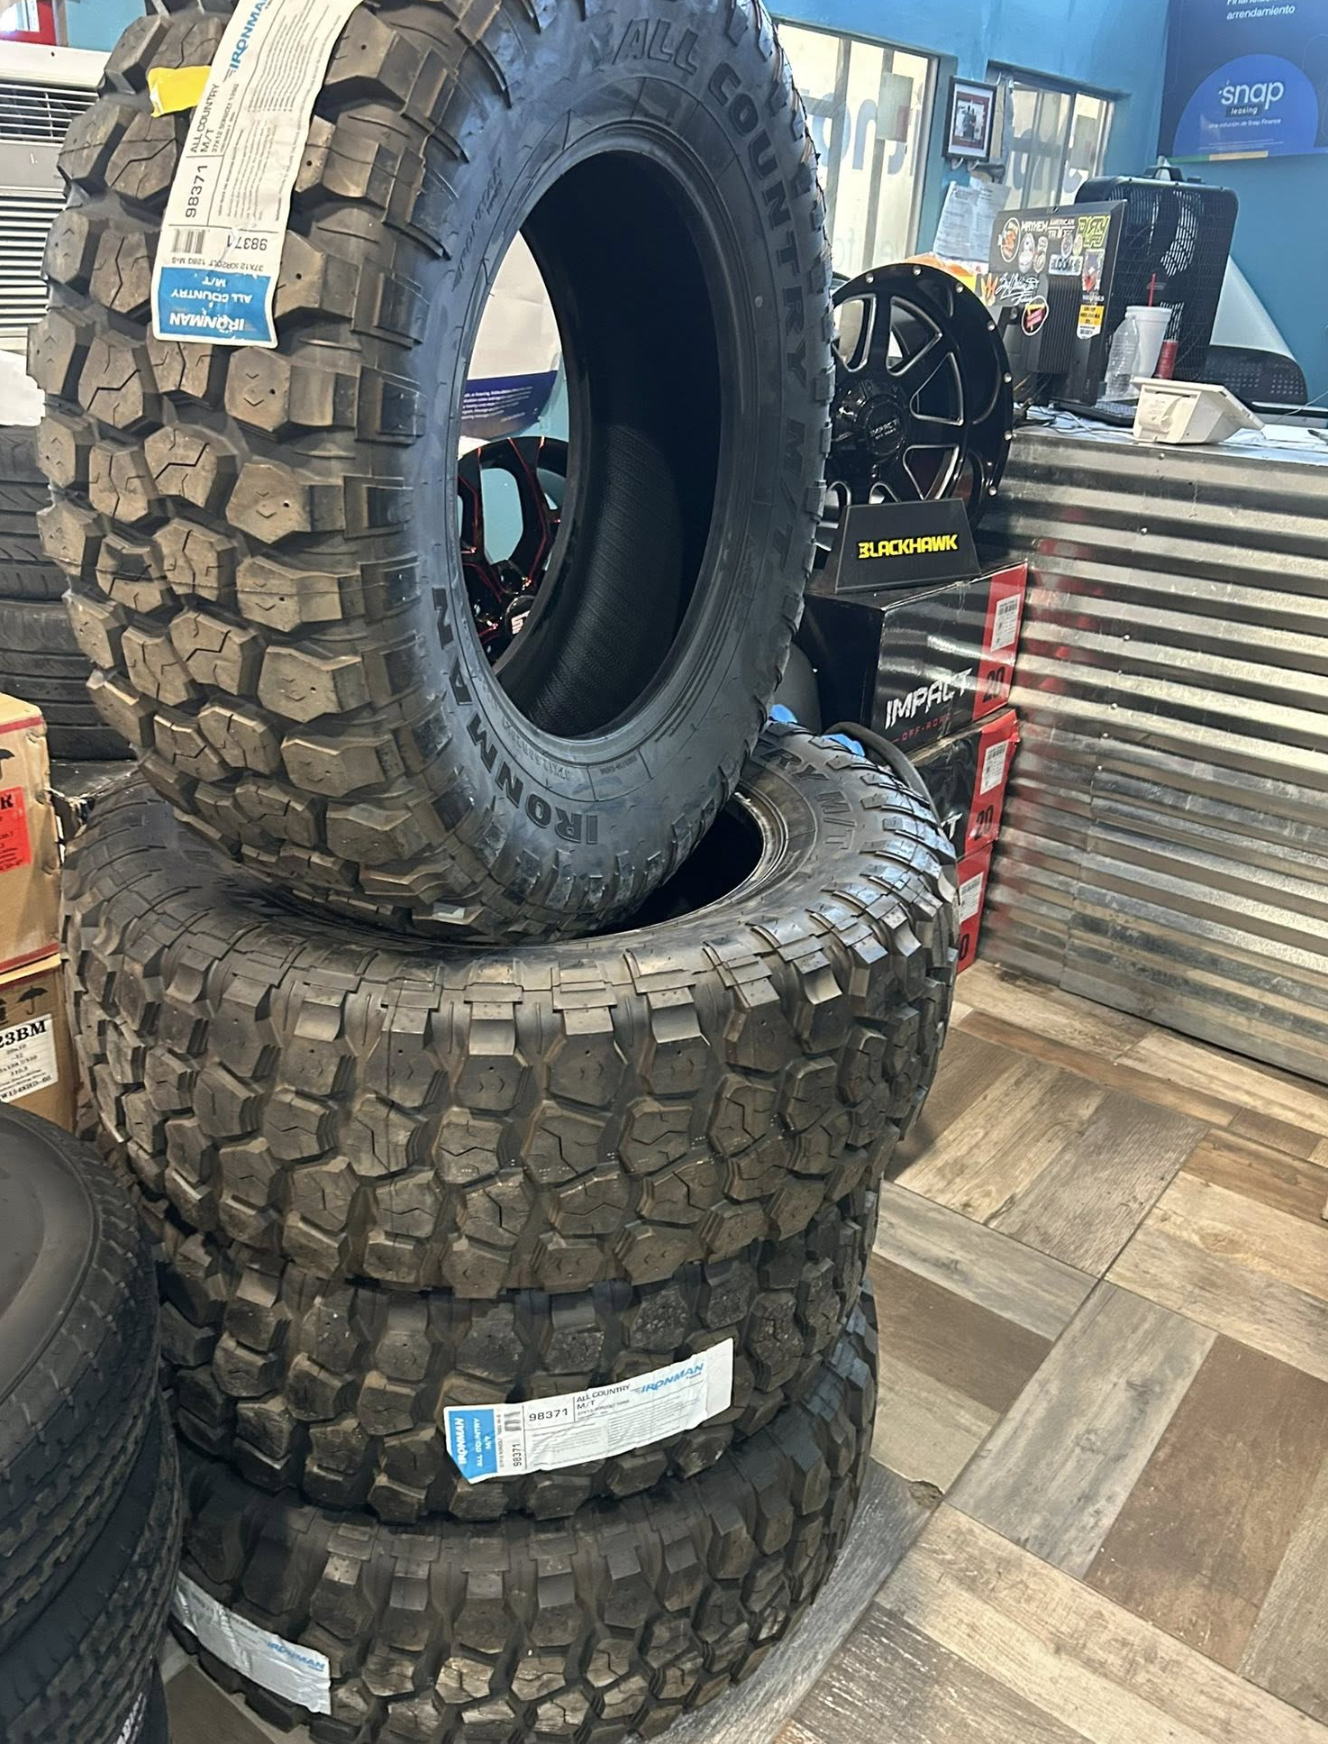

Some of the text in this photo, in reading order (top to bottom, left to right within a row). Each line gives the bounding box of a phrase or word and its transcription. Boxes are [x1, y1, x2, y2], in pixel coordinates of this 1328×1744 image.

[1226, 5, 1295, 20] arrendamiento
[229, 0, 269, 71] IRONMA
[1220, 81, 1284, 110] snap
[190, 83, 220, 154] ALL COUNTRY
[1230, 106, 1258, 115] leasing
[200, 128, 215, 153] M/T
[185, 164, 208, 219] 98371
[612, 18, 807, 386] ALL COUNTRY
[1021, 220, 1049, 231] MAYHEM
[226, 234, 268, 252] 98371
[202, 276, 226, 287] M/T
[170, 288, 253, 304] ALL COUNTRY
[169, 312, 245, 333] IRONMAN
[858, 534, 959, 559] BLACKHAWK
[885, 668, 973, 729] IMPACT
[982, 666, 1006, 704] 20
[431, 587, 599, 845] IRONMAN
[814, 790, 857, 850] M/T
[973, 804, 994, 841] 20
[576, 1393, 591, 1403] ALL
[592, 1384, 630, 1398] COUNTRY
[641, 1363, 704, 1393] IRONMAN
[528, 1408, 569, 1422] 98371
[576, 1400, 596, 1409] M/T
[454, 1417, 467, 1467] IRONMAN
[474, 1418, 483, 1454] COUNTRY
[512, 1443, 522, 1467] 98371
[267, 1642, 326, 1669] IRONMAN
